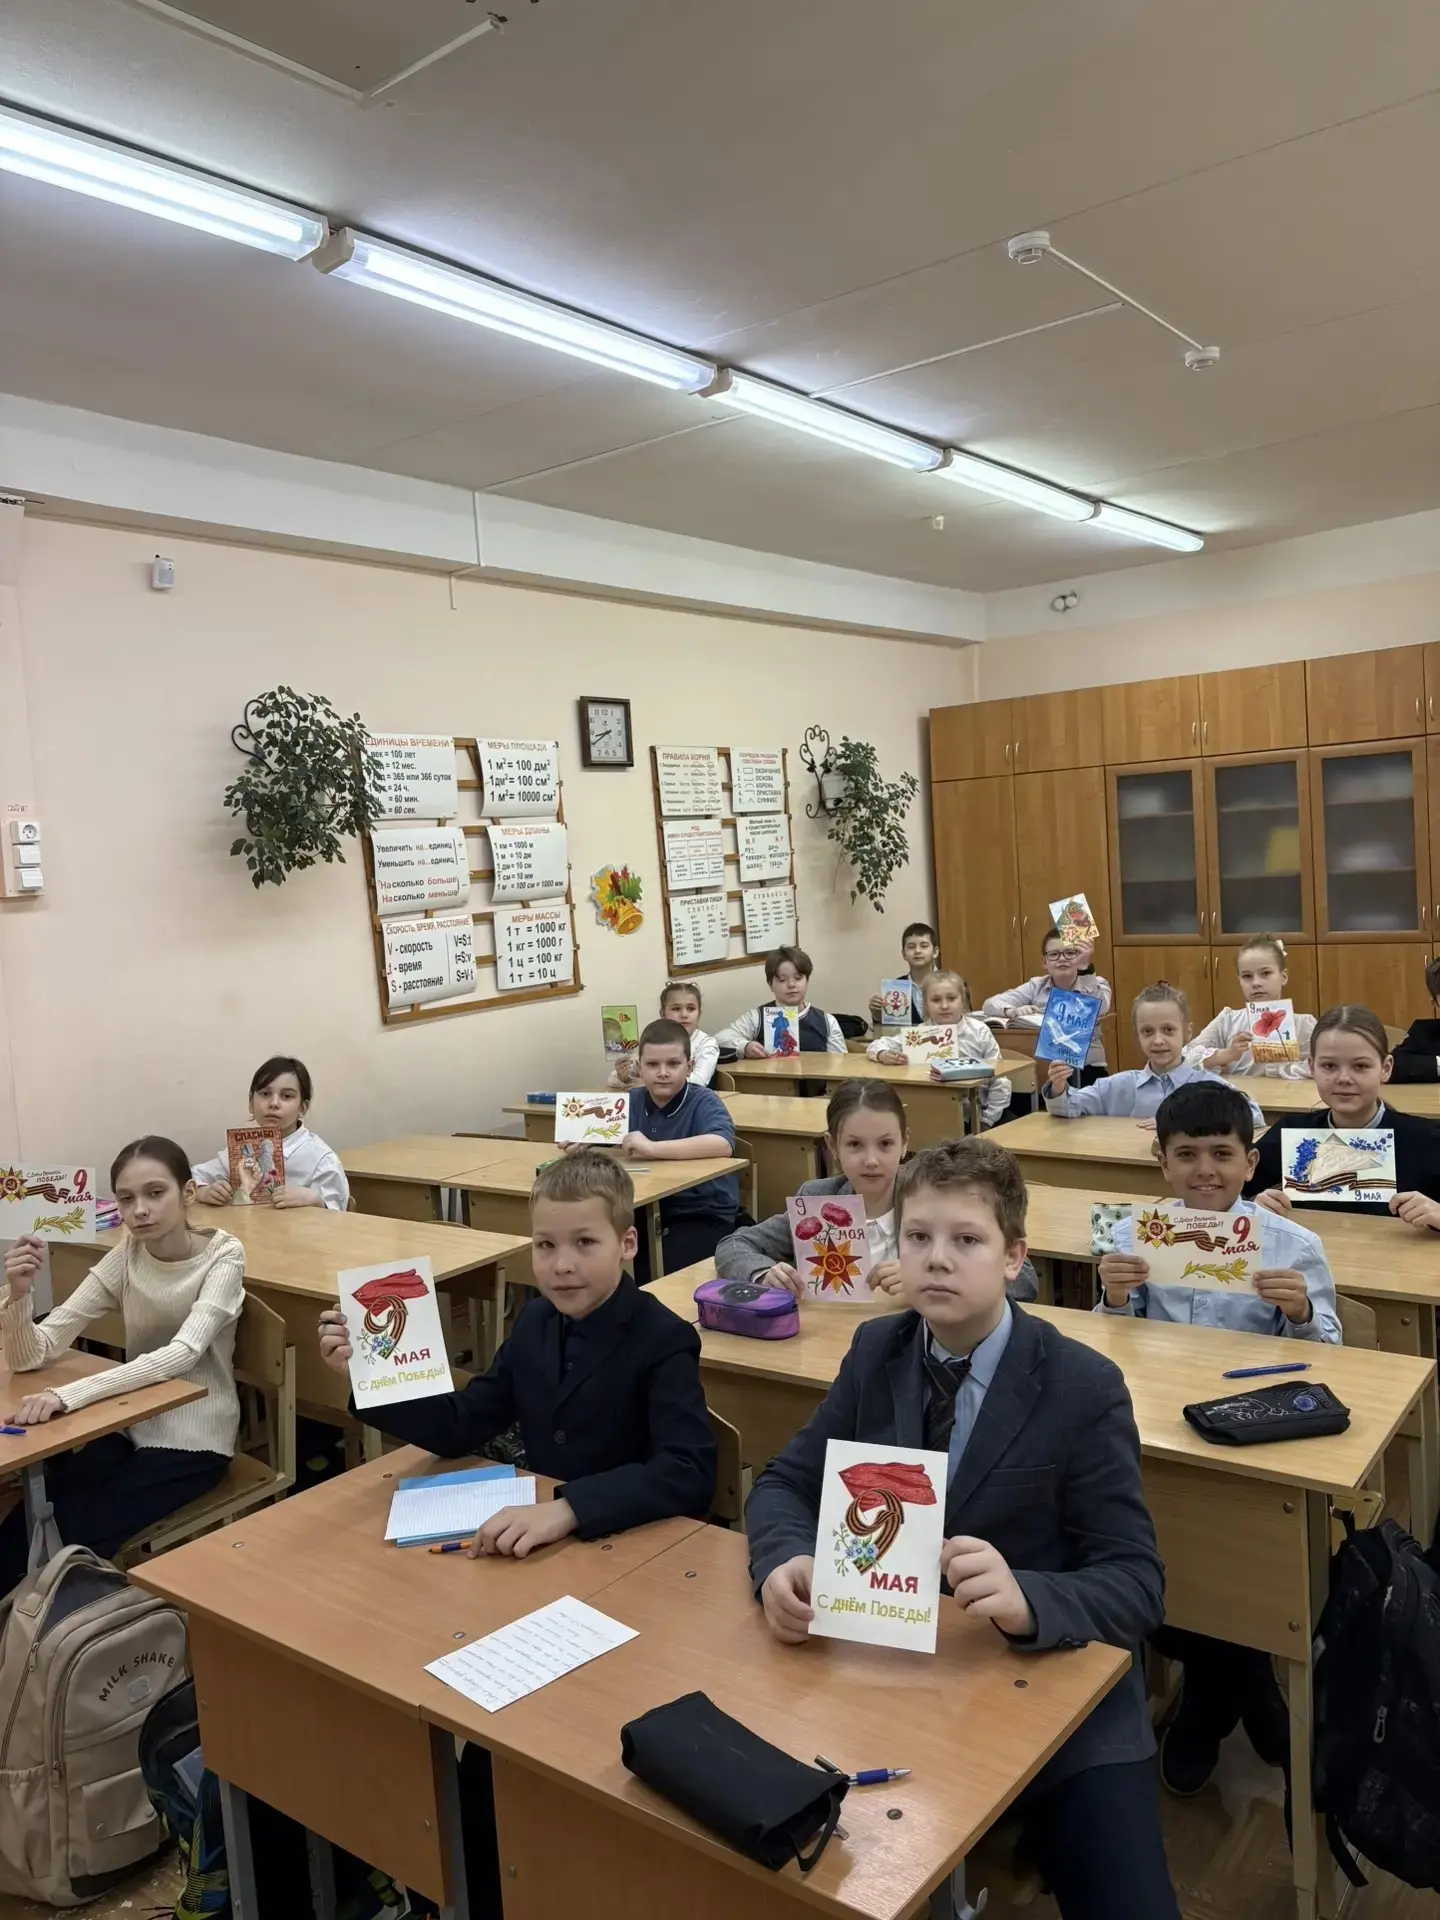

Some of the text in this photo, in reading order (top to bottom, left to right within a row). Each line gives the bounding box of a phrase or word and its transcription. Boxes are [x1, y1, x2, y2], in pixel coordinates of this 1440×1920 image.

[365, 738, 450, 748] ЕДИНИЦЫ ВРЕМЕНИ
[390, 750, 402, 758] 100
[663, 752, 690, 760] ПРАВИЛА
[393, 762, 400, 770] 12
[488, 759, 492, 770] 1
[516, 760, 531, 770] 100
[433, 774, 451, 782] суток
[517, 776, 533, 786] 100
[490, 791, 494, 802] 1
[518, 792, 540, 802] 10000
[394, 806, 402, 814] 60
[501, 828, 523, 836] МЕРЫ
[376, 844, 413, 853] Увеличить
[378, 860, 414, 868] Уменьшить
[517, 872, 523, 880] 10
[380, 880, 424, 890] Насколько
[516, 882, 526, 890] 100
[542, 880, 554, 888] 1000
[382, 893, 425, 903] Насколько
[512, 912, 560, 922] МЕРЫ МАССЫ
[437, 918, 470, 930] РАССТОЯНИЕ
[506, 922, 566, 936] 1 т 1000 кг
[388, 942, 433, 956] V скорость
[508, 942, 512, 952] 1
[516, 943, 525, 952] кг
[536, 936, 556, 948] 1000
[508, 952, 562, 968] 1 ц 100 кг
[399, 961, 422, 975] время
[510, 968, 556, 983] 1 т 10 ц
[391, 976, 444, 994] S расстояние
[1250, 1003, 1256, 1014] 9
[1056, 1003, 1088, 1029] 9 МАЯ
[945, 1028, 952, 1041] 9
[614, 1098, 626, 1115] 9
[234, 1130, 274, 1142] СПАСИБО
[74, 1169, 88, 1194] 9
[64, 1192, 94, 1204] мая
[1354, 1190, 1382, 1201] 9 МАЯ
[796, 1197, 806, 1216] 9
[1186, 1221, 1224, 1230] ПОБЕДЫ!
[1232, 1216, 1251, 1244] 9
[1222, 1241, 1260, 1256] мая
[394, 1348, 431, 1366] МАЯ
[358, 1381, 368, 1391] С
[870, 1572, 919, 1594] МАЯ
[818, 1594, 829, 1609] С
[99, 1652, 175, 1702] MILK SHAKE
